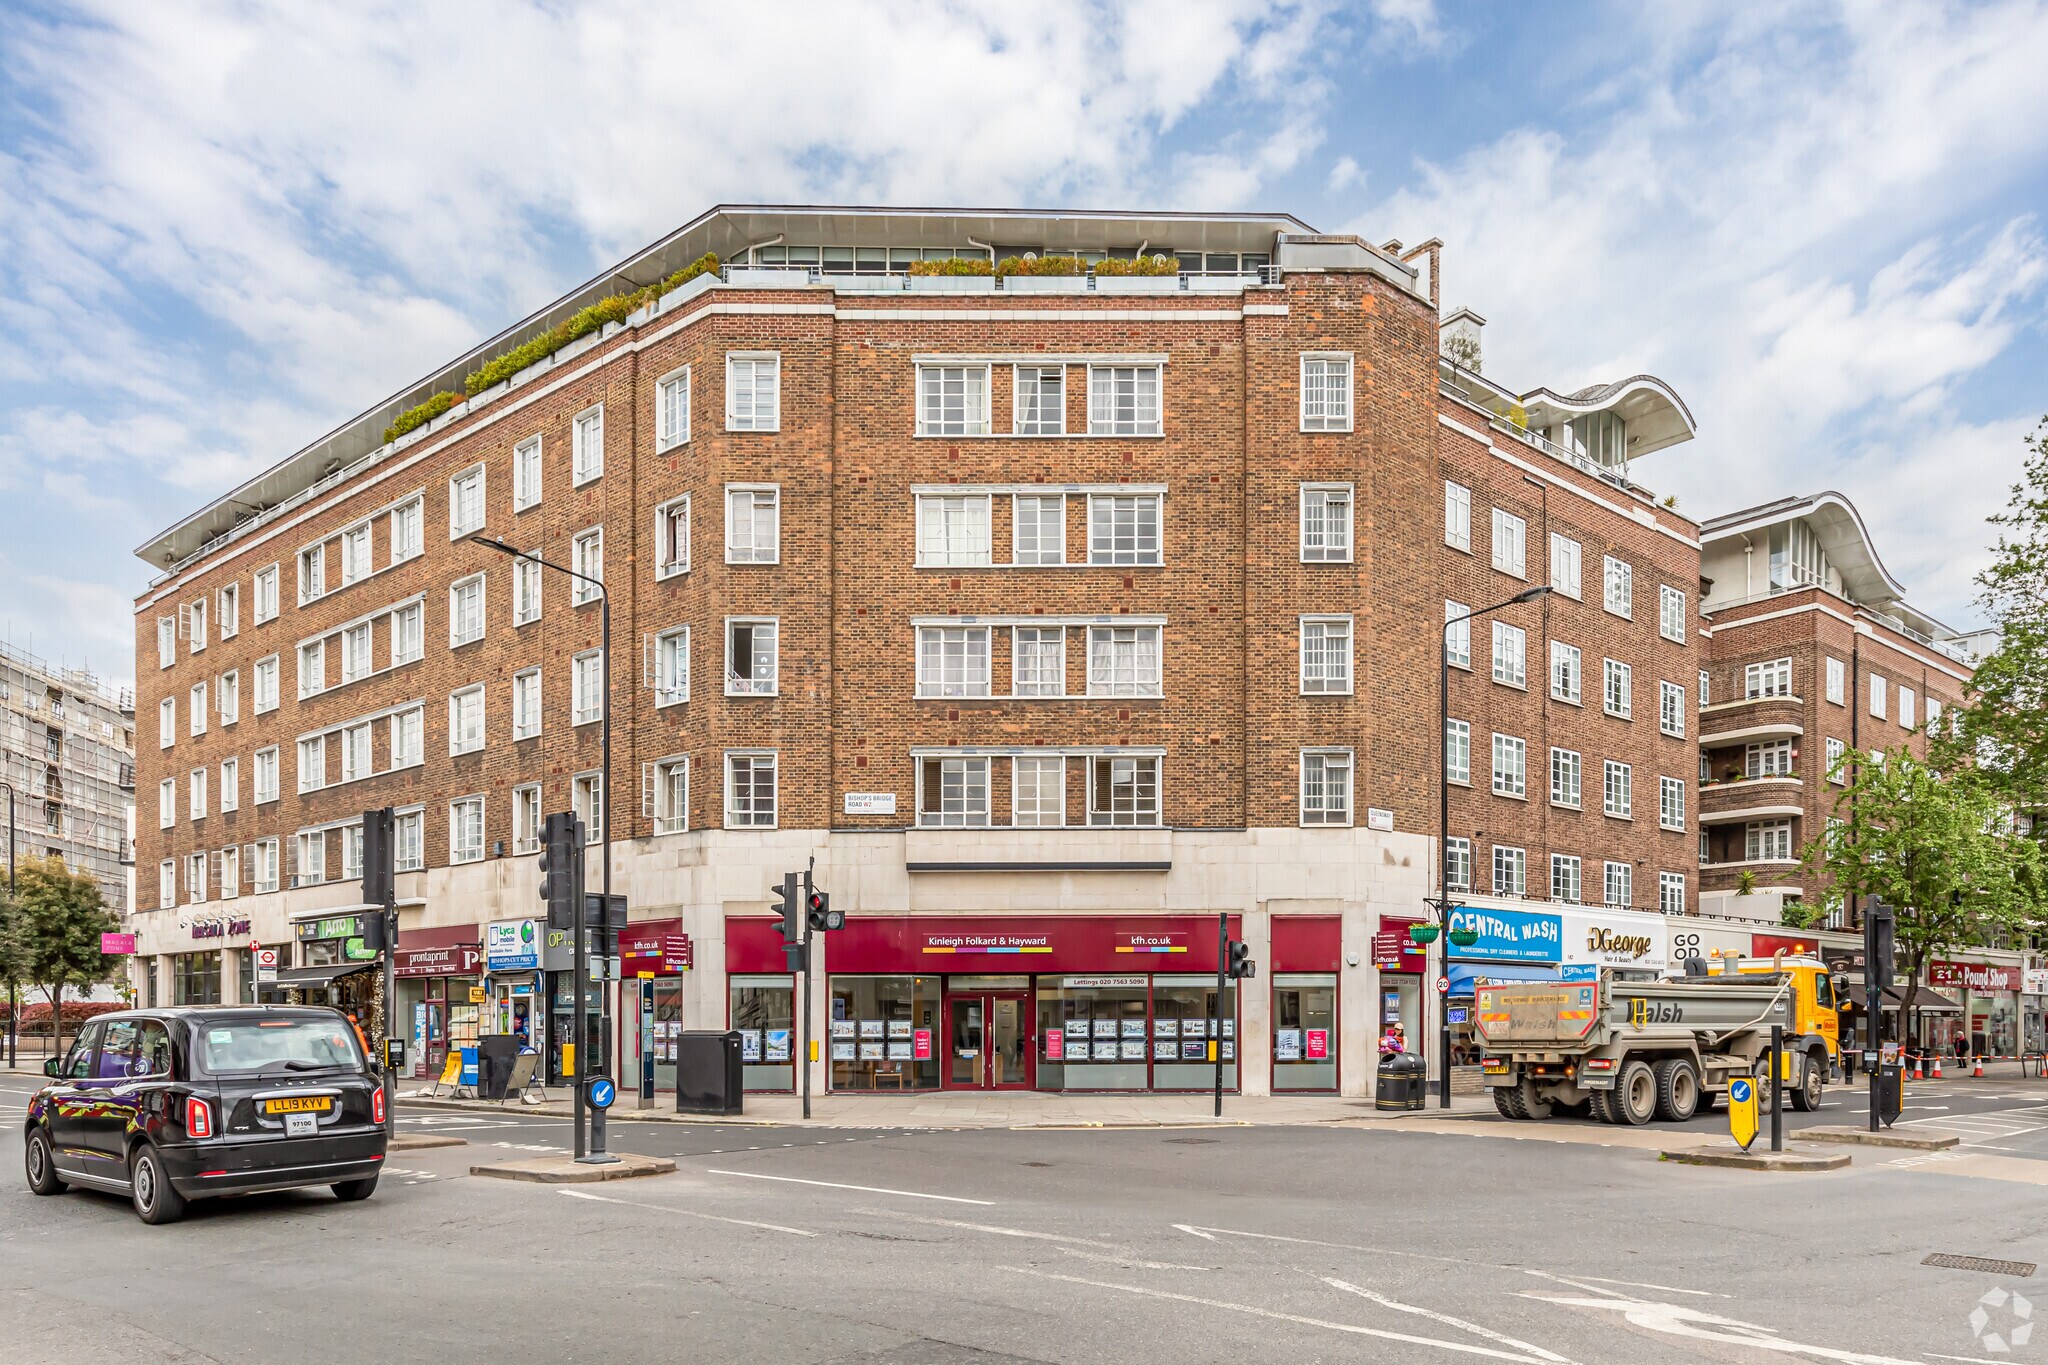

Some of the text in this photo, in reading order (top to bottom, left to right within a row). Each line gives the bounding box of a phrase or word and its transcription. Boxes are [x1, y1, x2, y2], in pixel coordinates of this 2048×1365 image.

[499, 926, 515, 935] Lyca
[1449, 911, 1558, 942] CENTRAL WASH
[634, 941, 658, 950] kfh.co.uk
[928, 937, 1047, 947] Kinleigh Folkard & Hayward
[1131, 936, 1171, 945] kfh.co.uk
[1674, 934, 1700, 947] GO
[409, 951, 449, 966] prontaprint
[1619, 956, 1632, 964] Beauty
[1674, 947, 1700, 960] OD
[463, 951, 479, 970] P
[1563, 967, 1583, 977] CENTRAL
[1964, 967, 2008, 989] Pound Shop
[1626, 1001, 1683, 1023] Walsh
[1511, 1019, 1556, 1029] Walsh
[273, 1097, 323, 1111] LL19 KYV
